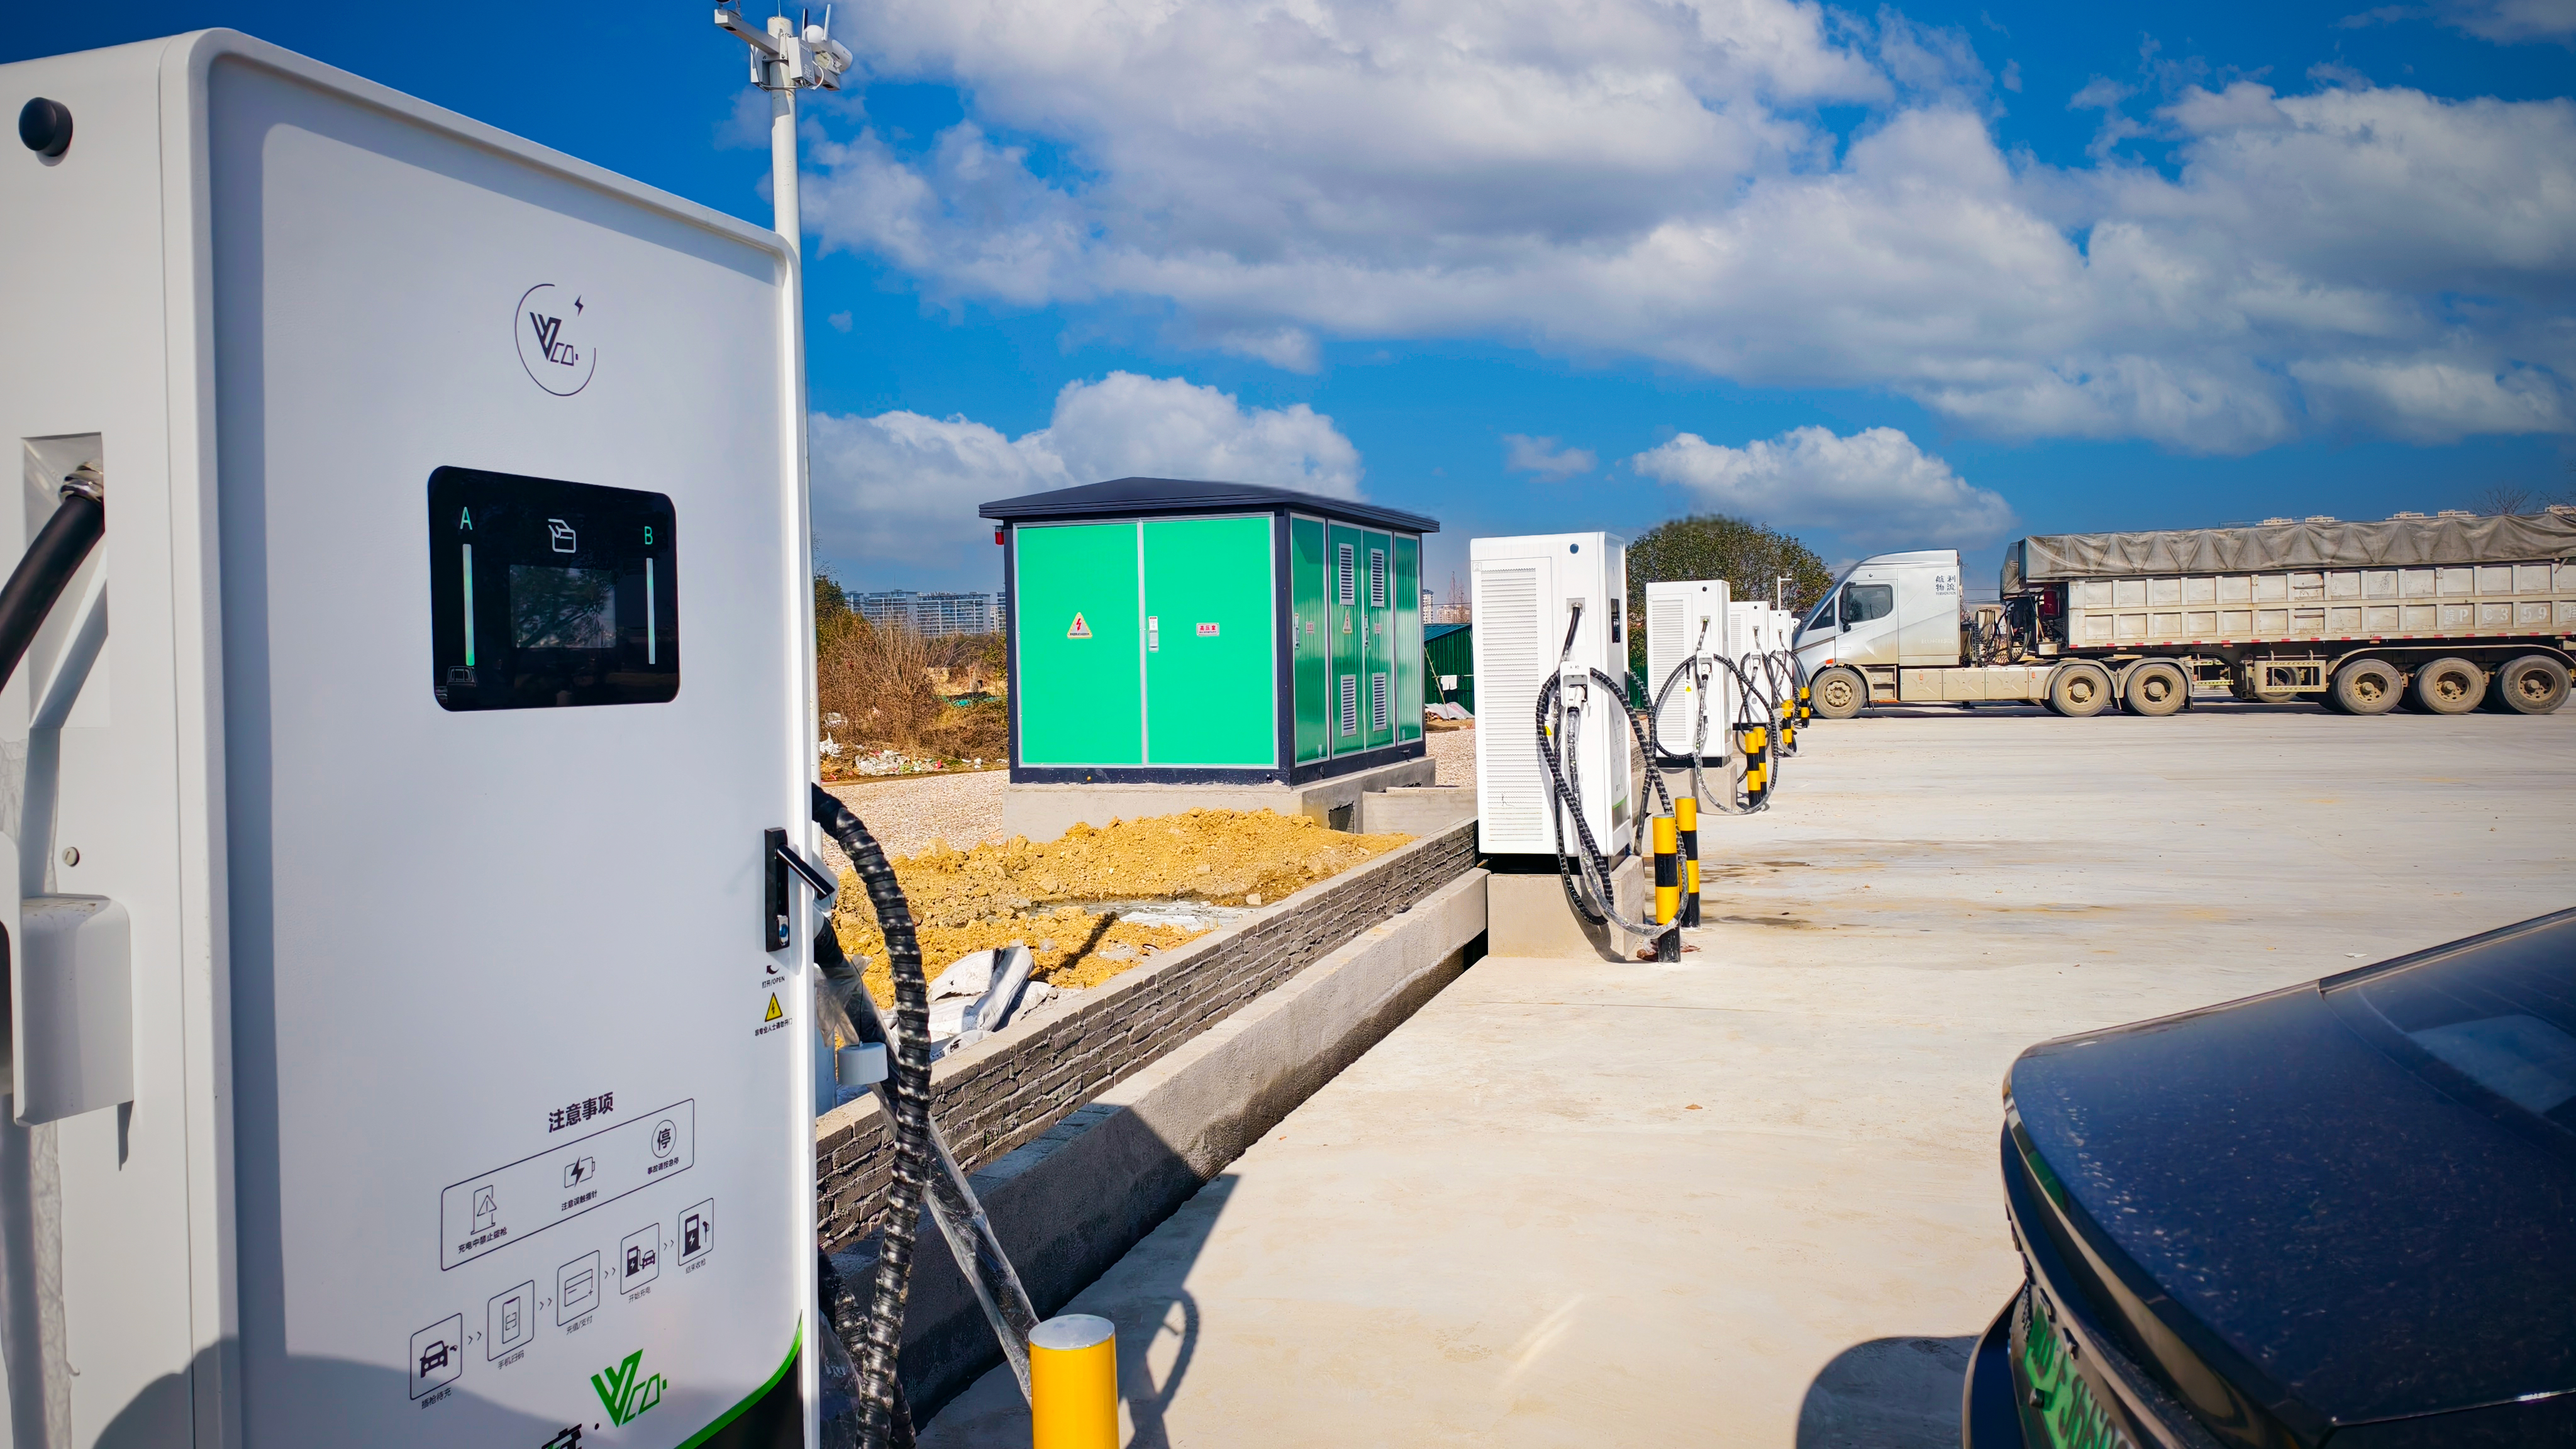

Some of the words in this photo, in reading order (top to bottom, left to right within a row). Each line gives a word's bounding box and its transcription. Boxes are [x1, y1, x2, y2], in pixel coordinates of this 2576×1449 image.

[460, 506, 472, 530] A
[644, 526, 653, 545] B
[1935, 583, 1956, 592] 物流
[548, 1091, 614, 1133] 注意事项
[657, 1128, 671, 1151] 停
[629, 1286, 651, 1304] 开始充电
[566, 1315, 593, 1336] 充值/支付
